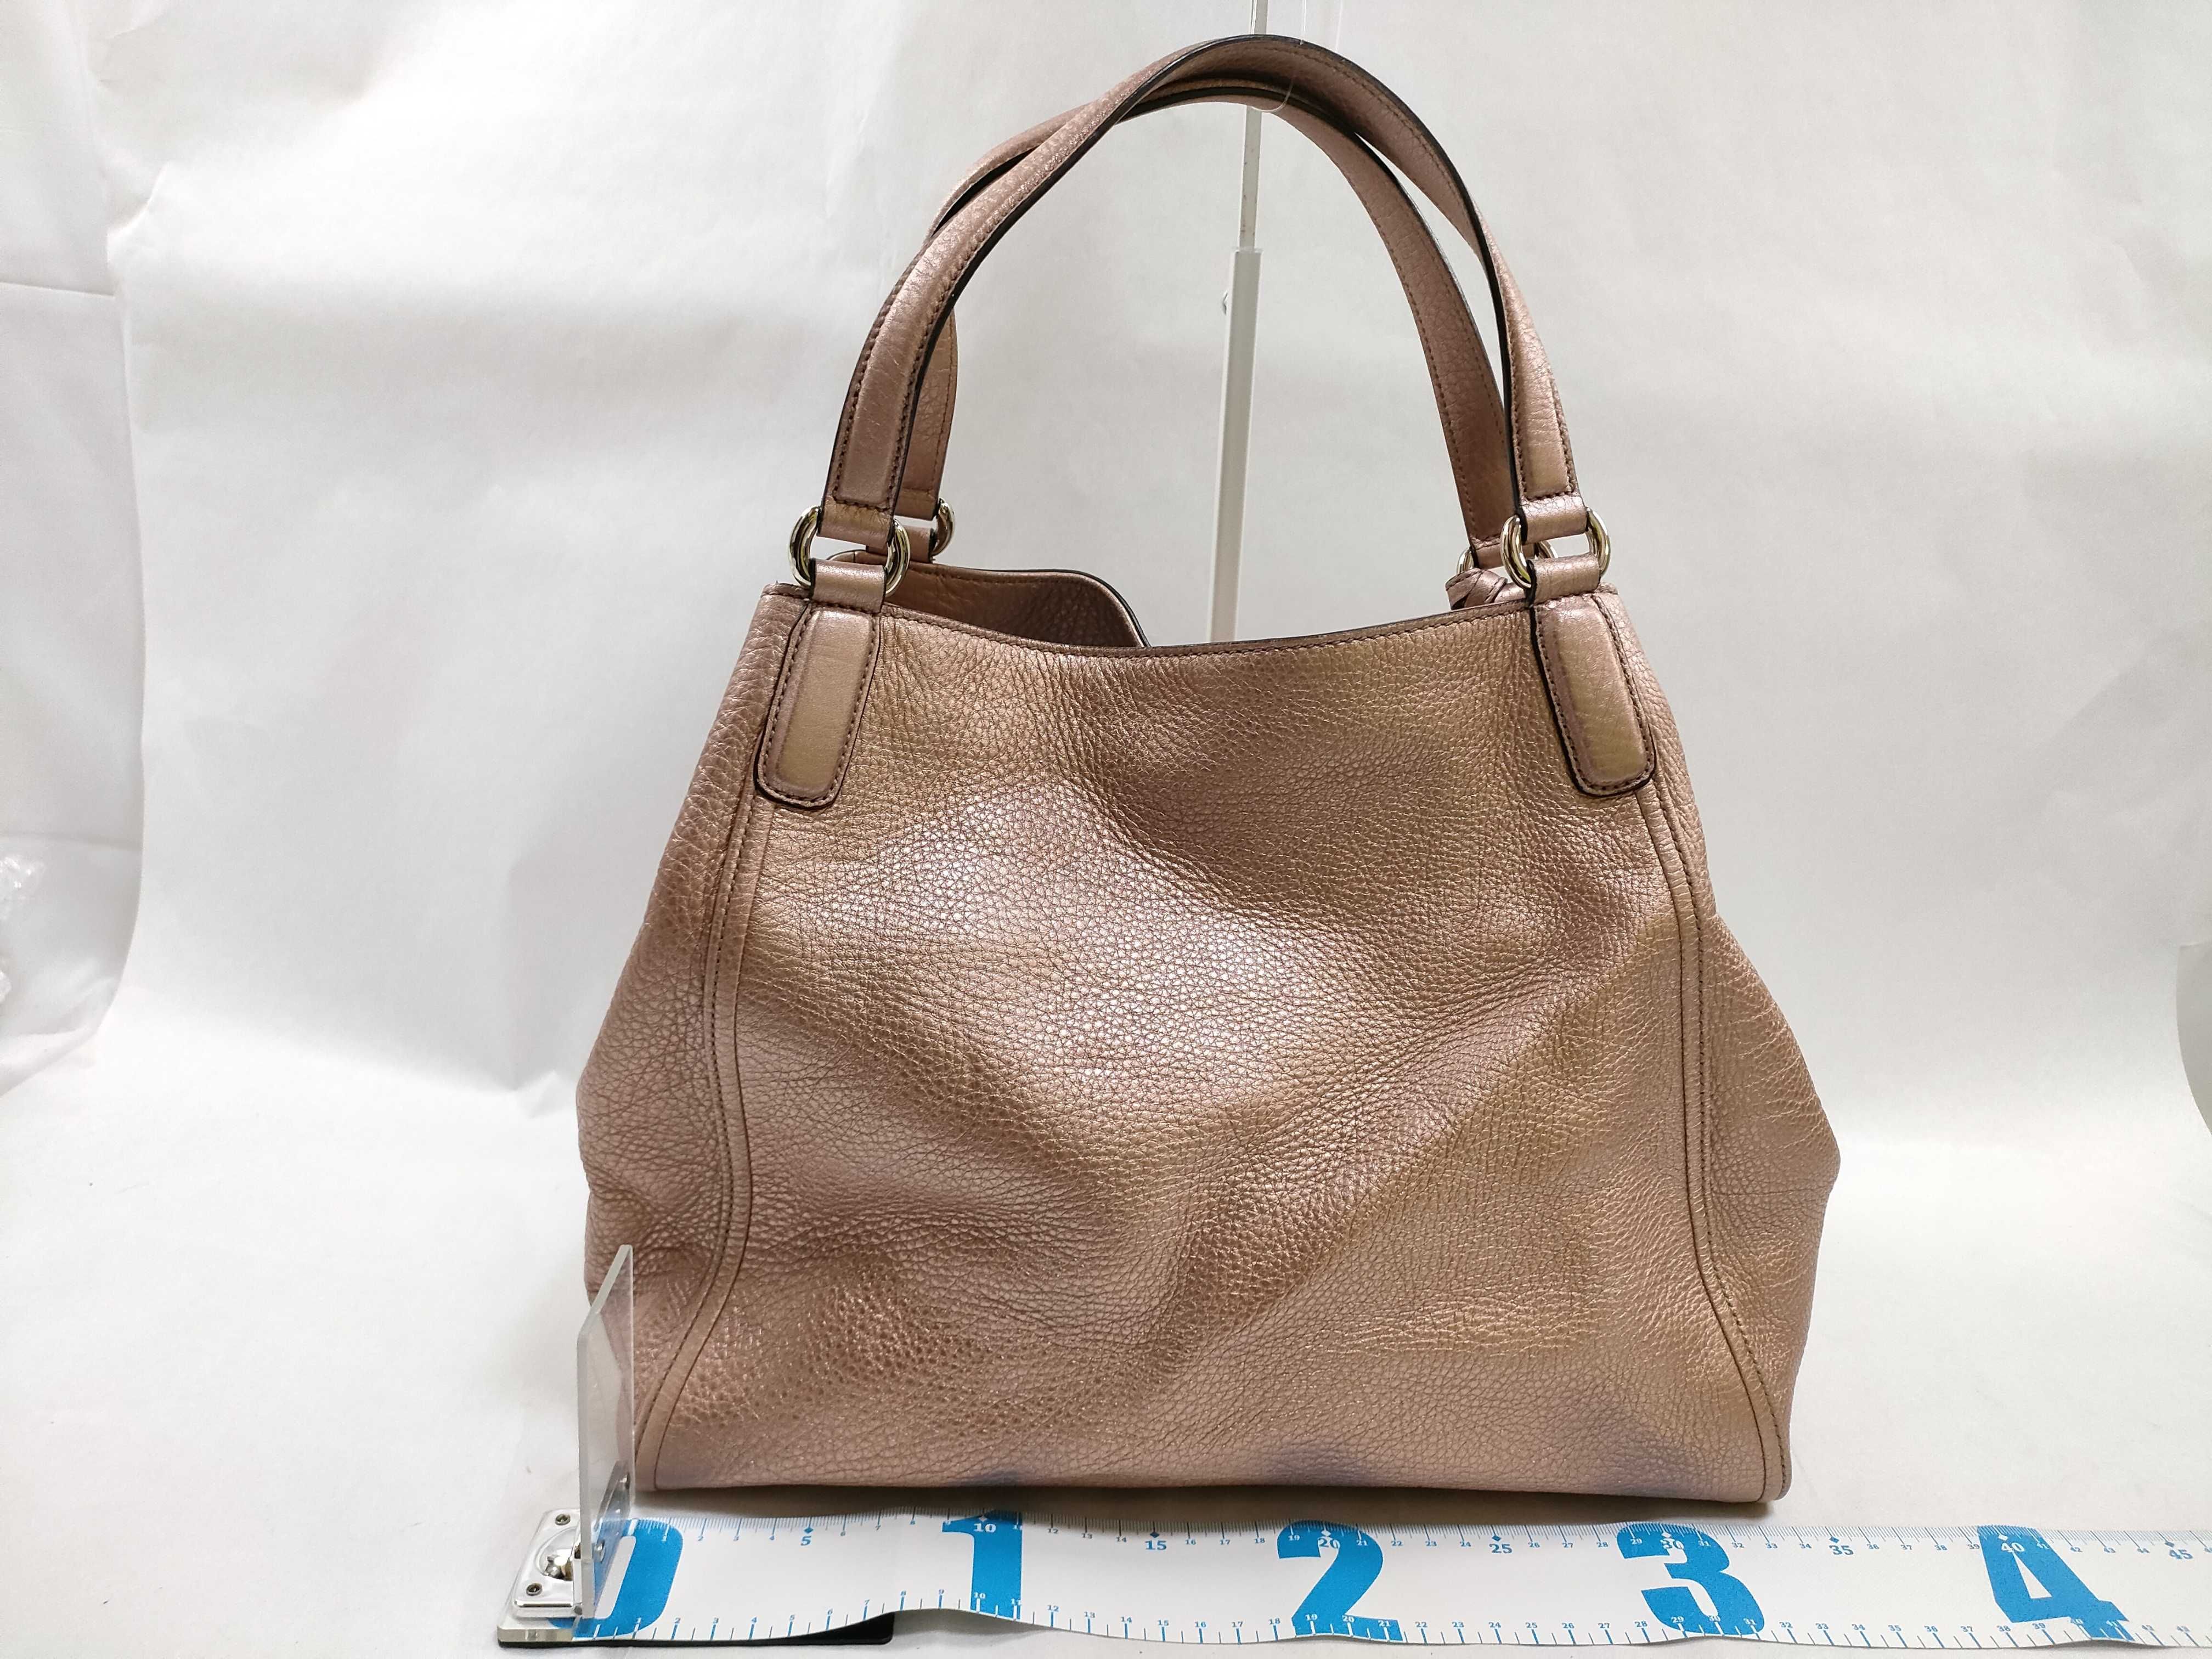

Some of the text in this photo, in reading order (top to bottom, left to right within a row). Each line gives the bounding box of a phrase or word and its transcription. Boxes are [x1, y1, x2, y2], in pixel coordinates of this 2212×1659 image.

[800, 1536, 811, 1545] 5
[974, 1523, 996, 1532] 10
[1146, 1540, 1167, 1550] 15
[1318, 1538, 1340, 1549] 20
[1489, 1543, 1513, 1554] 25
[1660, 1538, 1684, 1550] 30
[1829, 1545, 1854, 1555] 35
[2001, 1542, 2025, 1552] 40
[2169, 1549, 2193, 1559] 45
[942, 1509, 1023, 1621] 1
[1277, 1520, 1403, 1641] 2
[1617, 1522, 1765, 1635] 3
[1977, 1524, 2135, 1641] 4
[1342, 1615, 1355, 1623] 20
